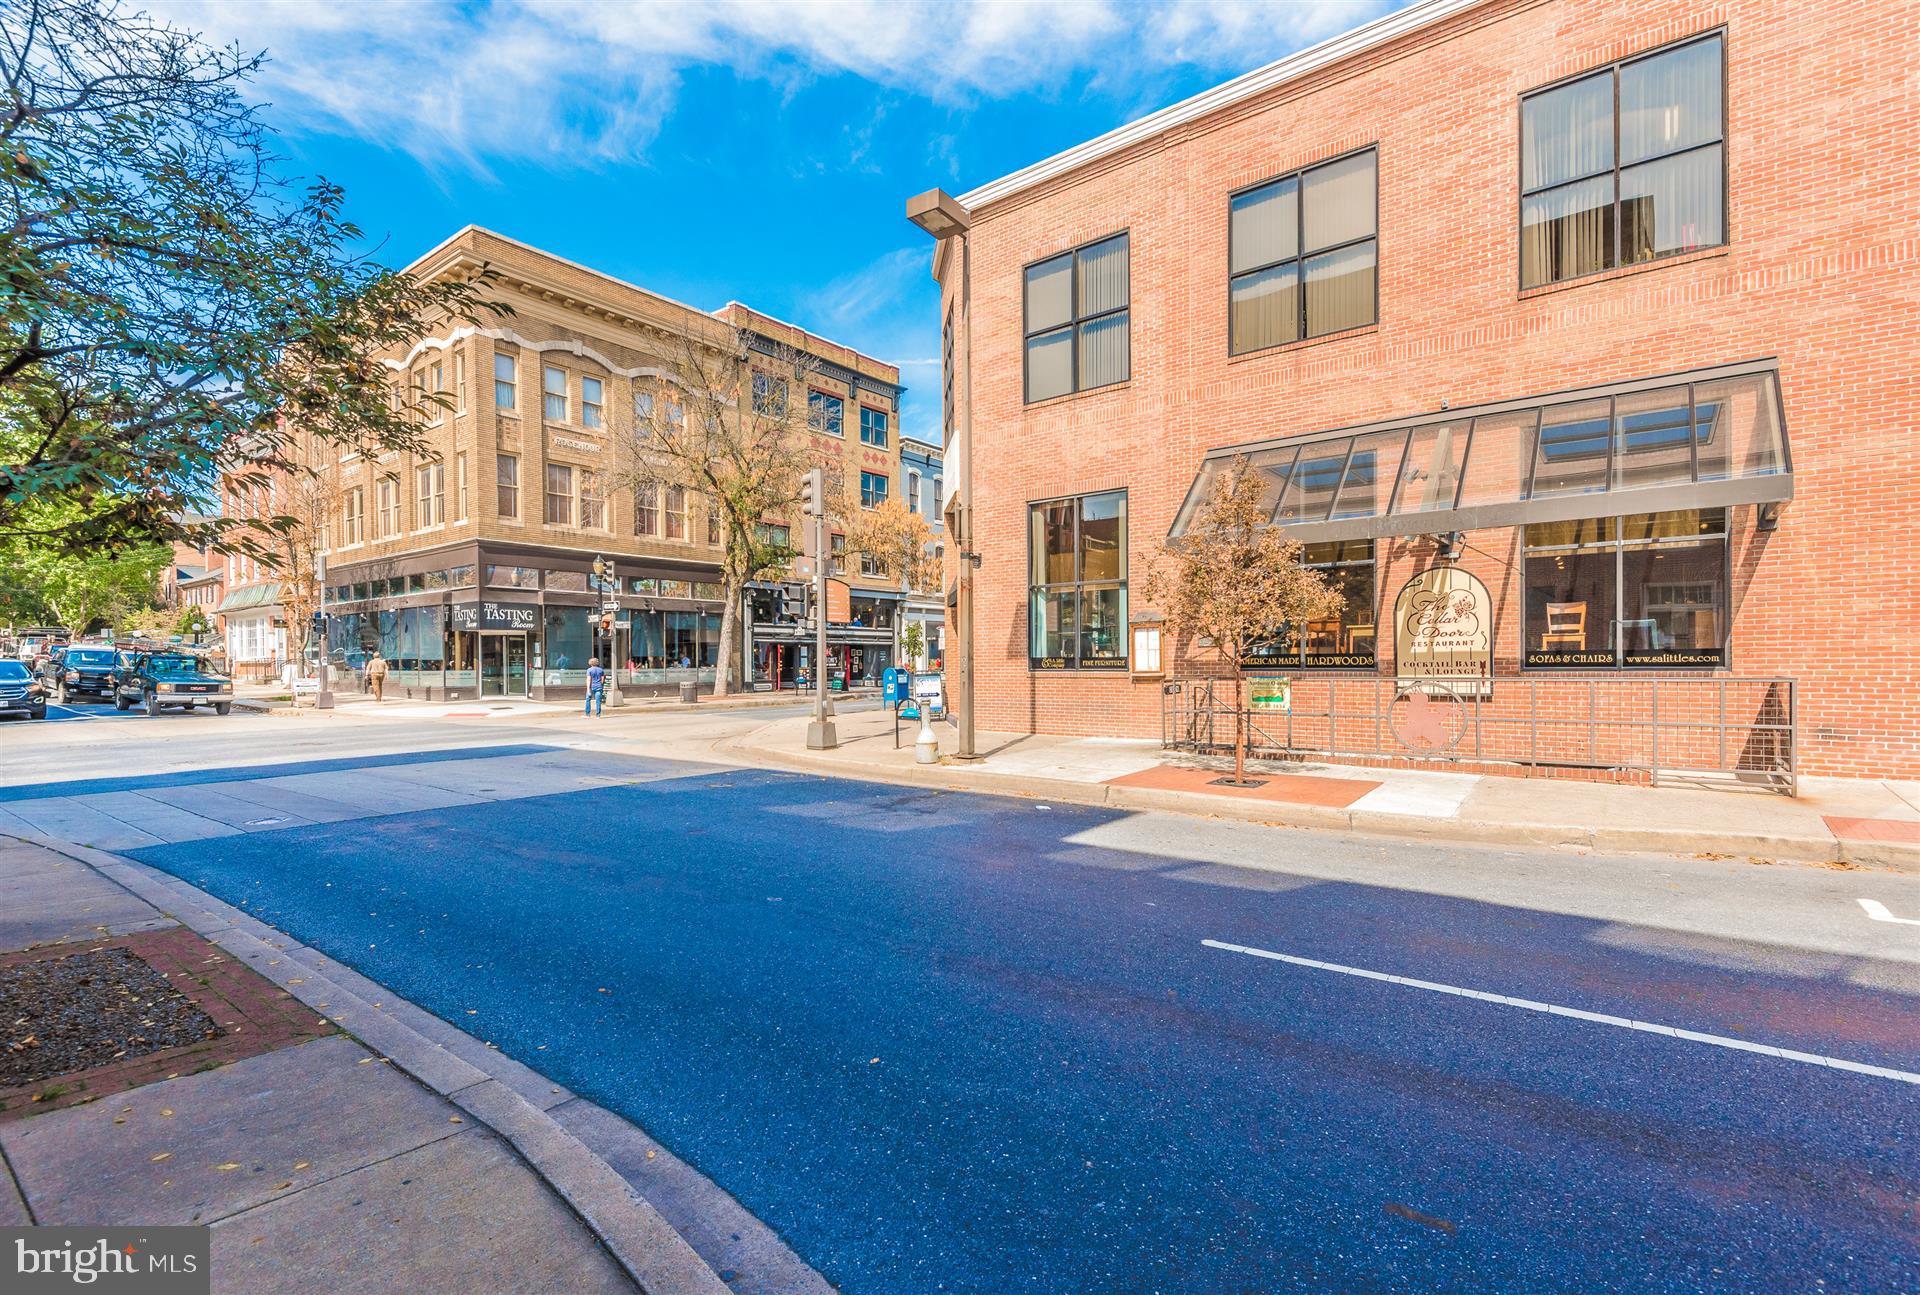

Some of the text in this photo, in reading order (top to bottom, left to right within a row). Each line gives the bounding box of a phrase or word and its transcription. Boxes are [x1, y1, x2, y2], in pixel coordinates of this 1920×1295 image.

[1418, 592, 1448, 612] The
[454, 608, 477, 621] TASTING
[484, 609, 533, 621] TASTING
[1416, 611, 1461, 625] Cellar
[511, 620, 535, 629] Room
[1421, 626, 1466, 638] Door
[1241, 657, 1300, 665] AMERICAN MADE
[1306, 656, 1374, 666] HARDWOODS
[1528, 654, 1614, 664] SOFAS & CHAIRS
[1626, 653, 1720, 664] www.salittles.com
